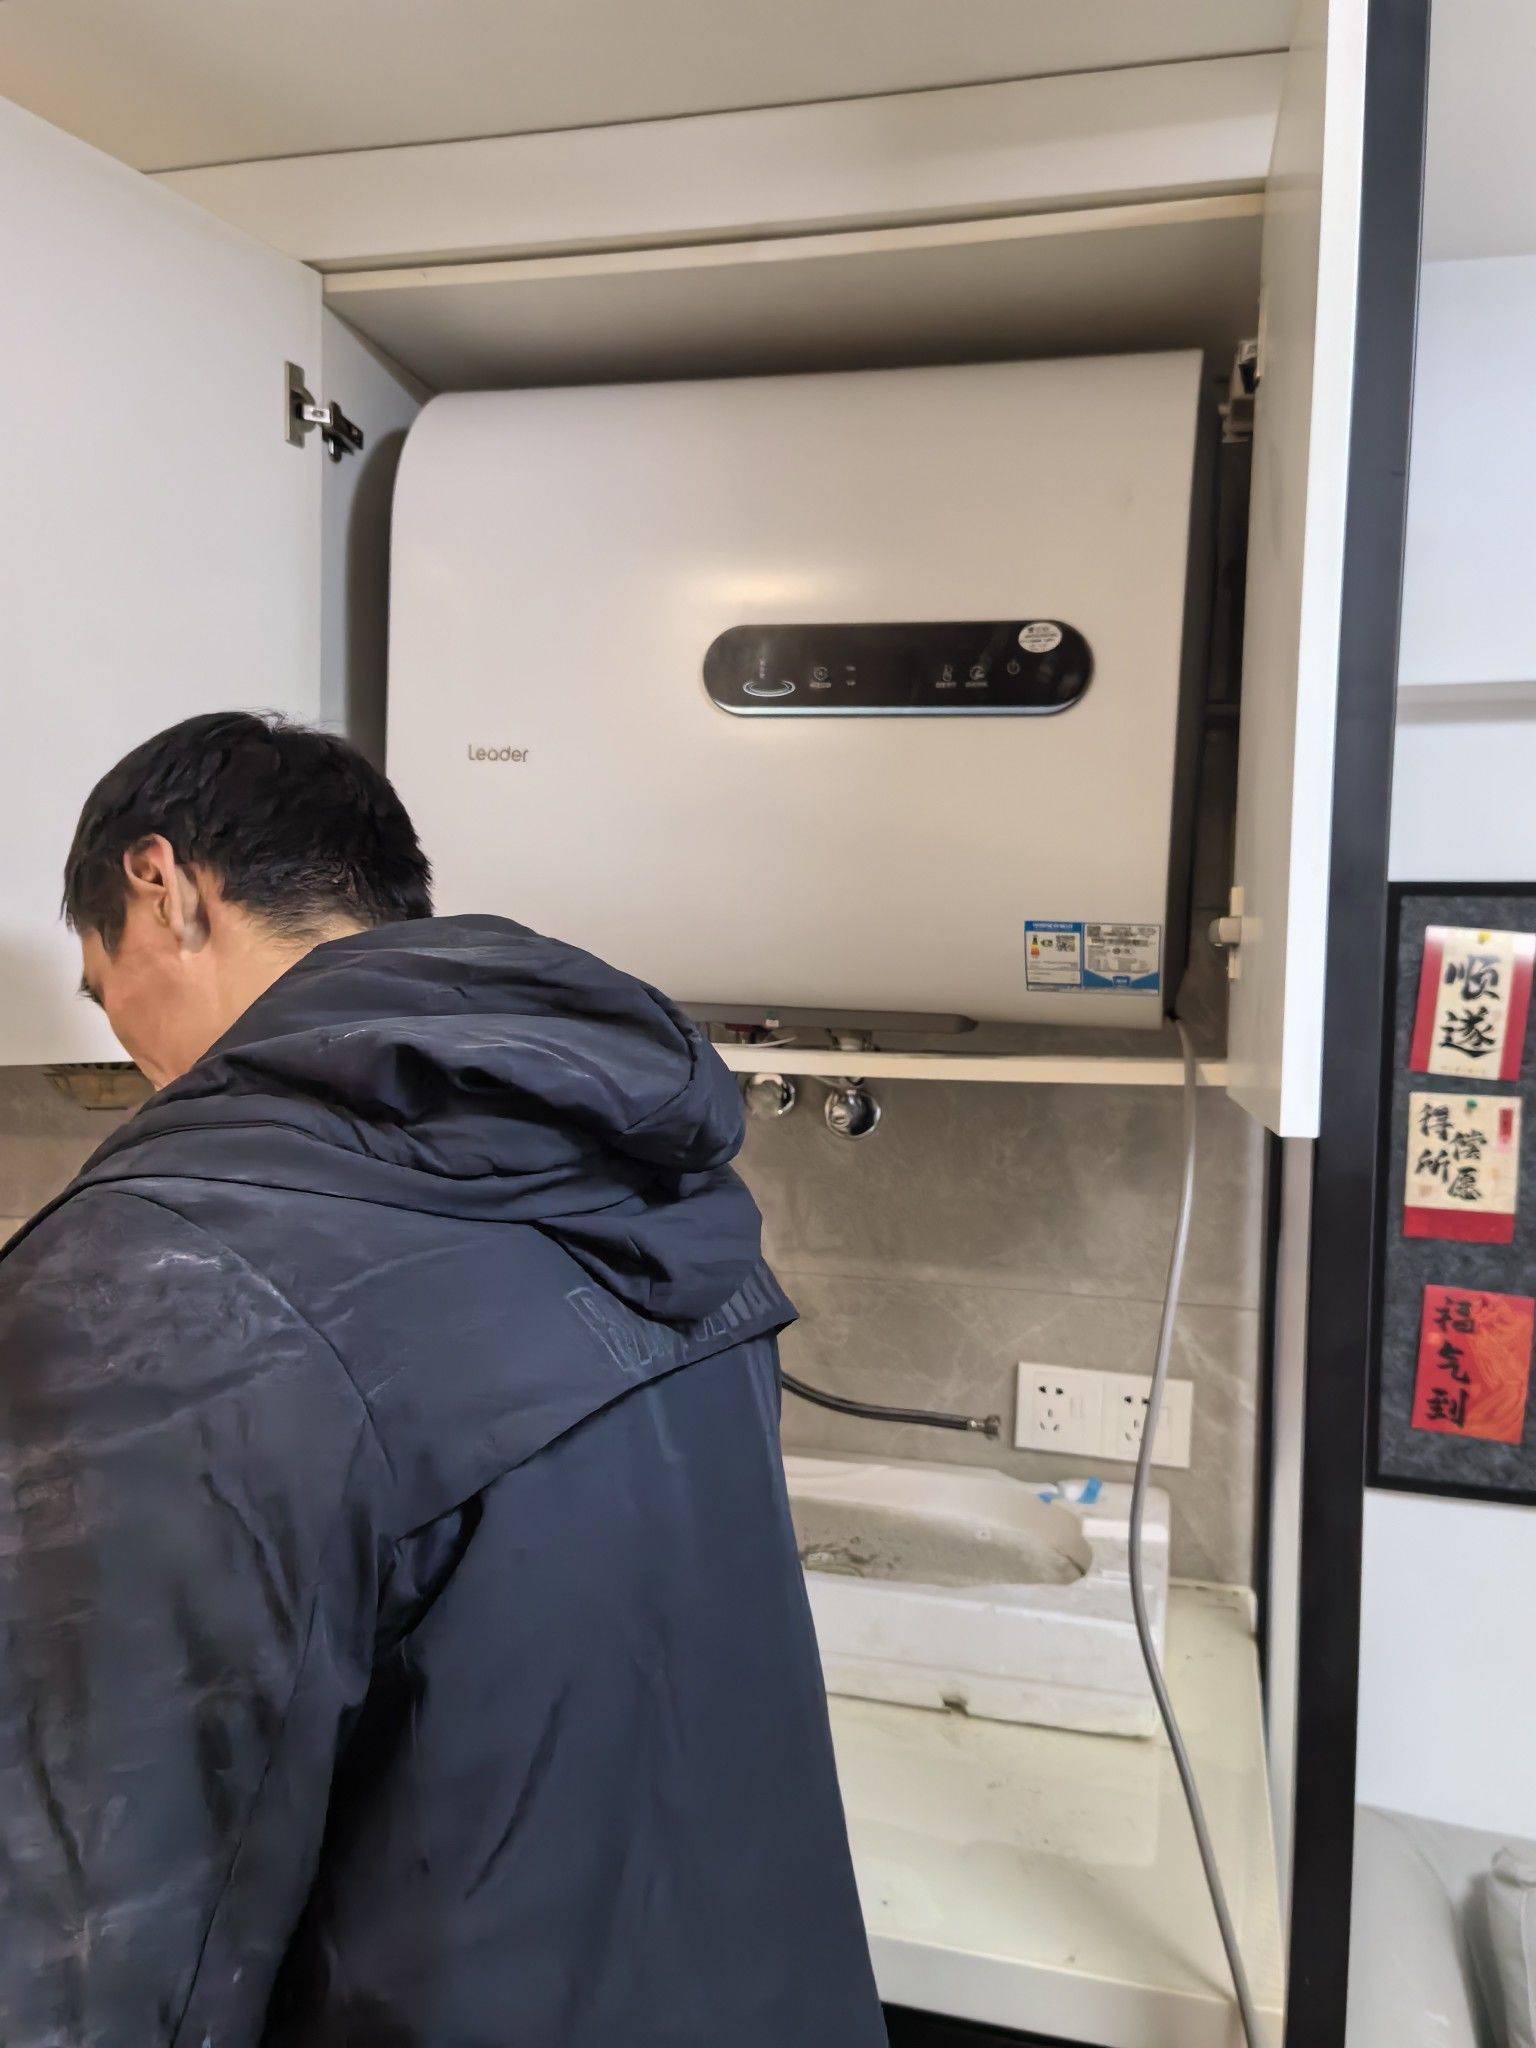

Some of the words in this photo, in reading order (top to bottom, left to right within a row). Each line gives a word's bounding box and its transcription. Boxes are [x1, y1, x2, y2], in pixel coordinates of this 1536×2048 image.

[468, 744, 528, 762] Leader
[1440, 955, 1500, 1058] 顺遂
[1427, 1297, 1475, 1428] 福气到
